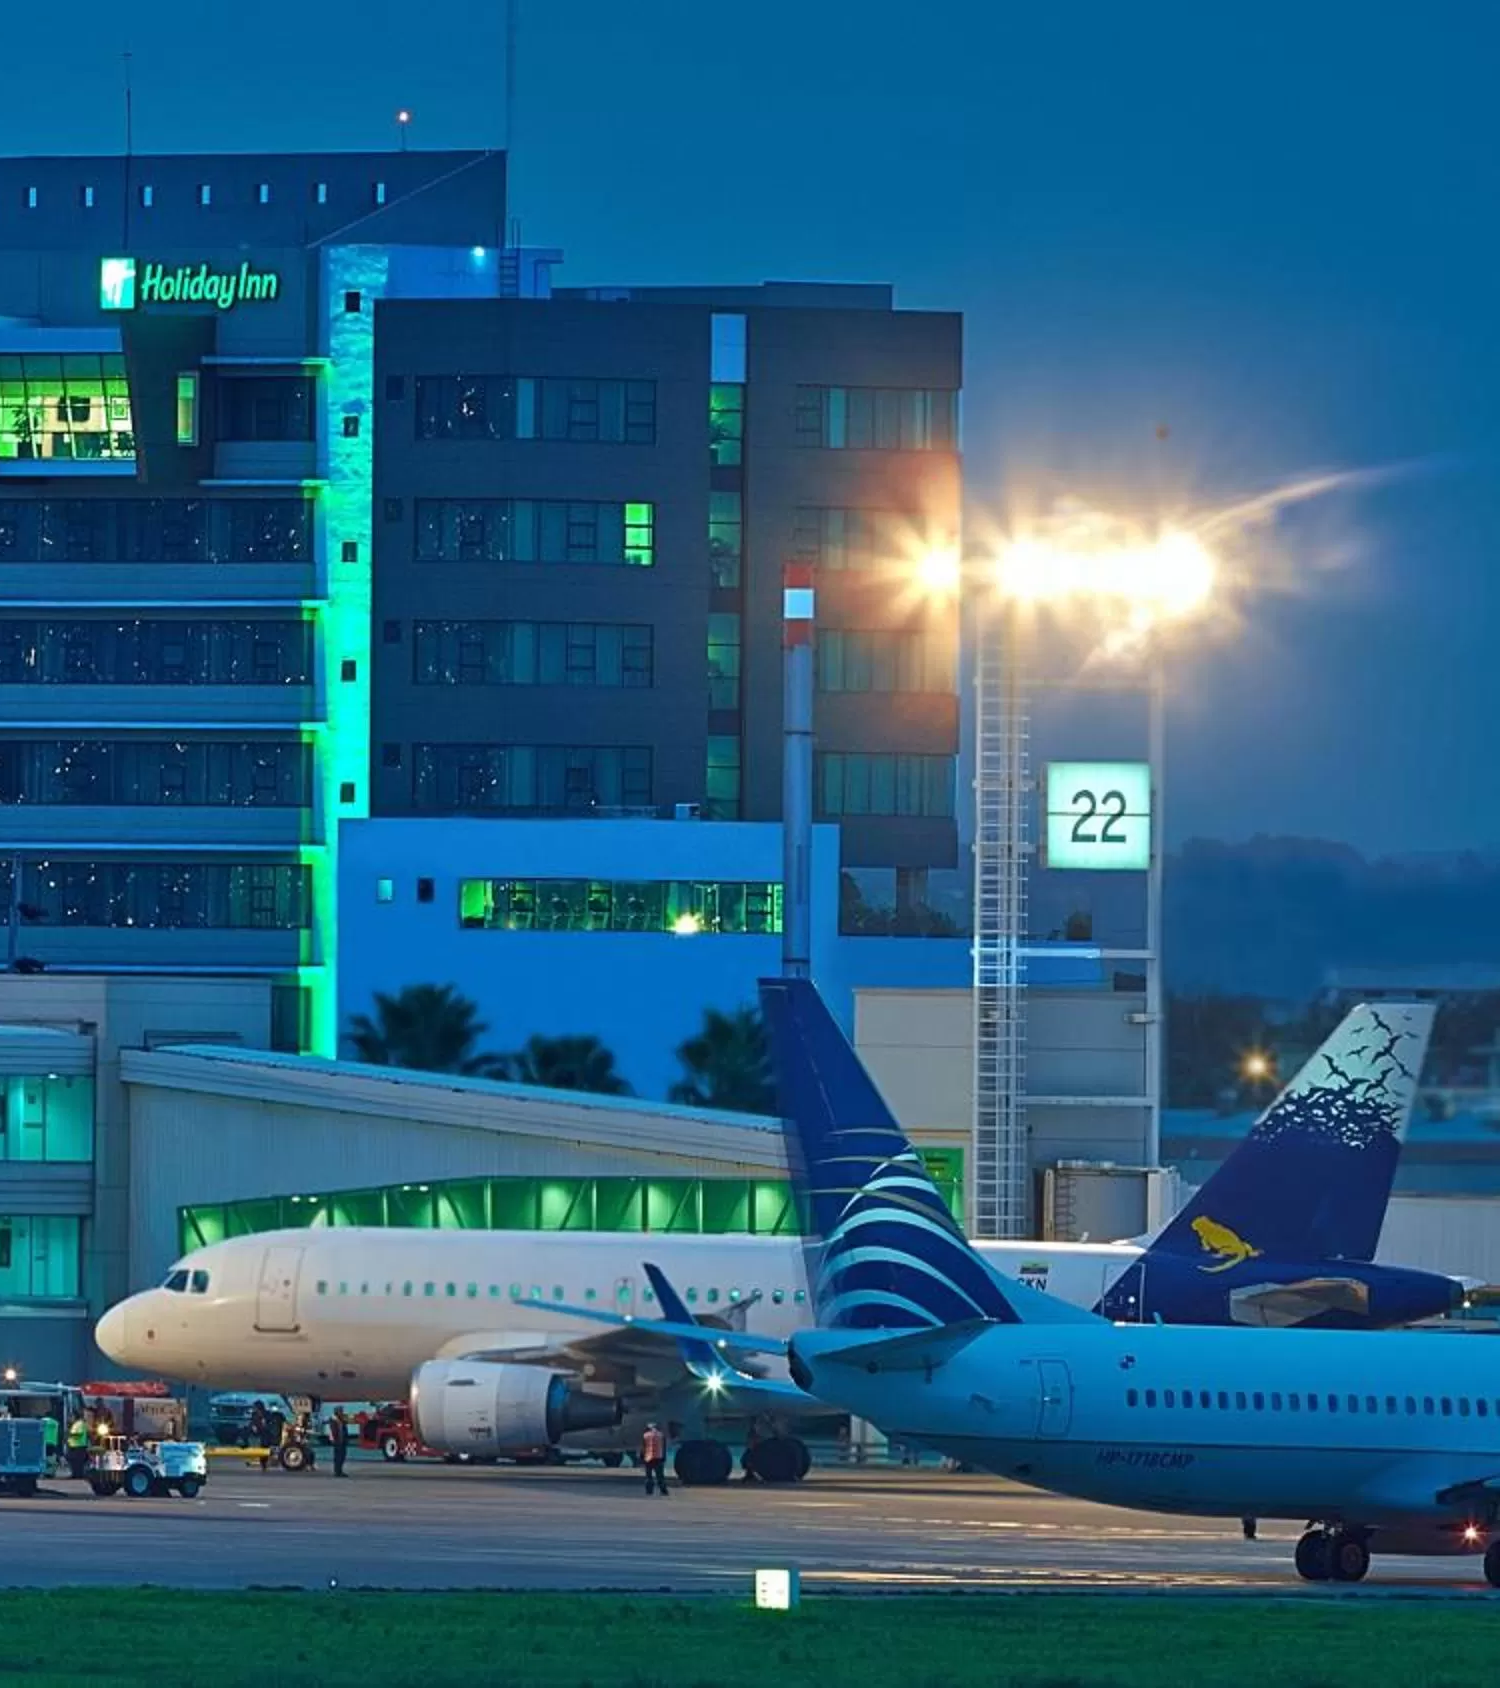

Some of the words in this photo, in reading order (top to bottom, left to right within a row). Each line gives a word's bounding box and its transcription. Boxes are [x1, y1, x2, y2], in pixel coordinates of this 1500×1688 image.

[141, 263, 236, 309] Holiday
[237, 261, 277, 300] Inn
[1071, 789, 1127, 843] 22
